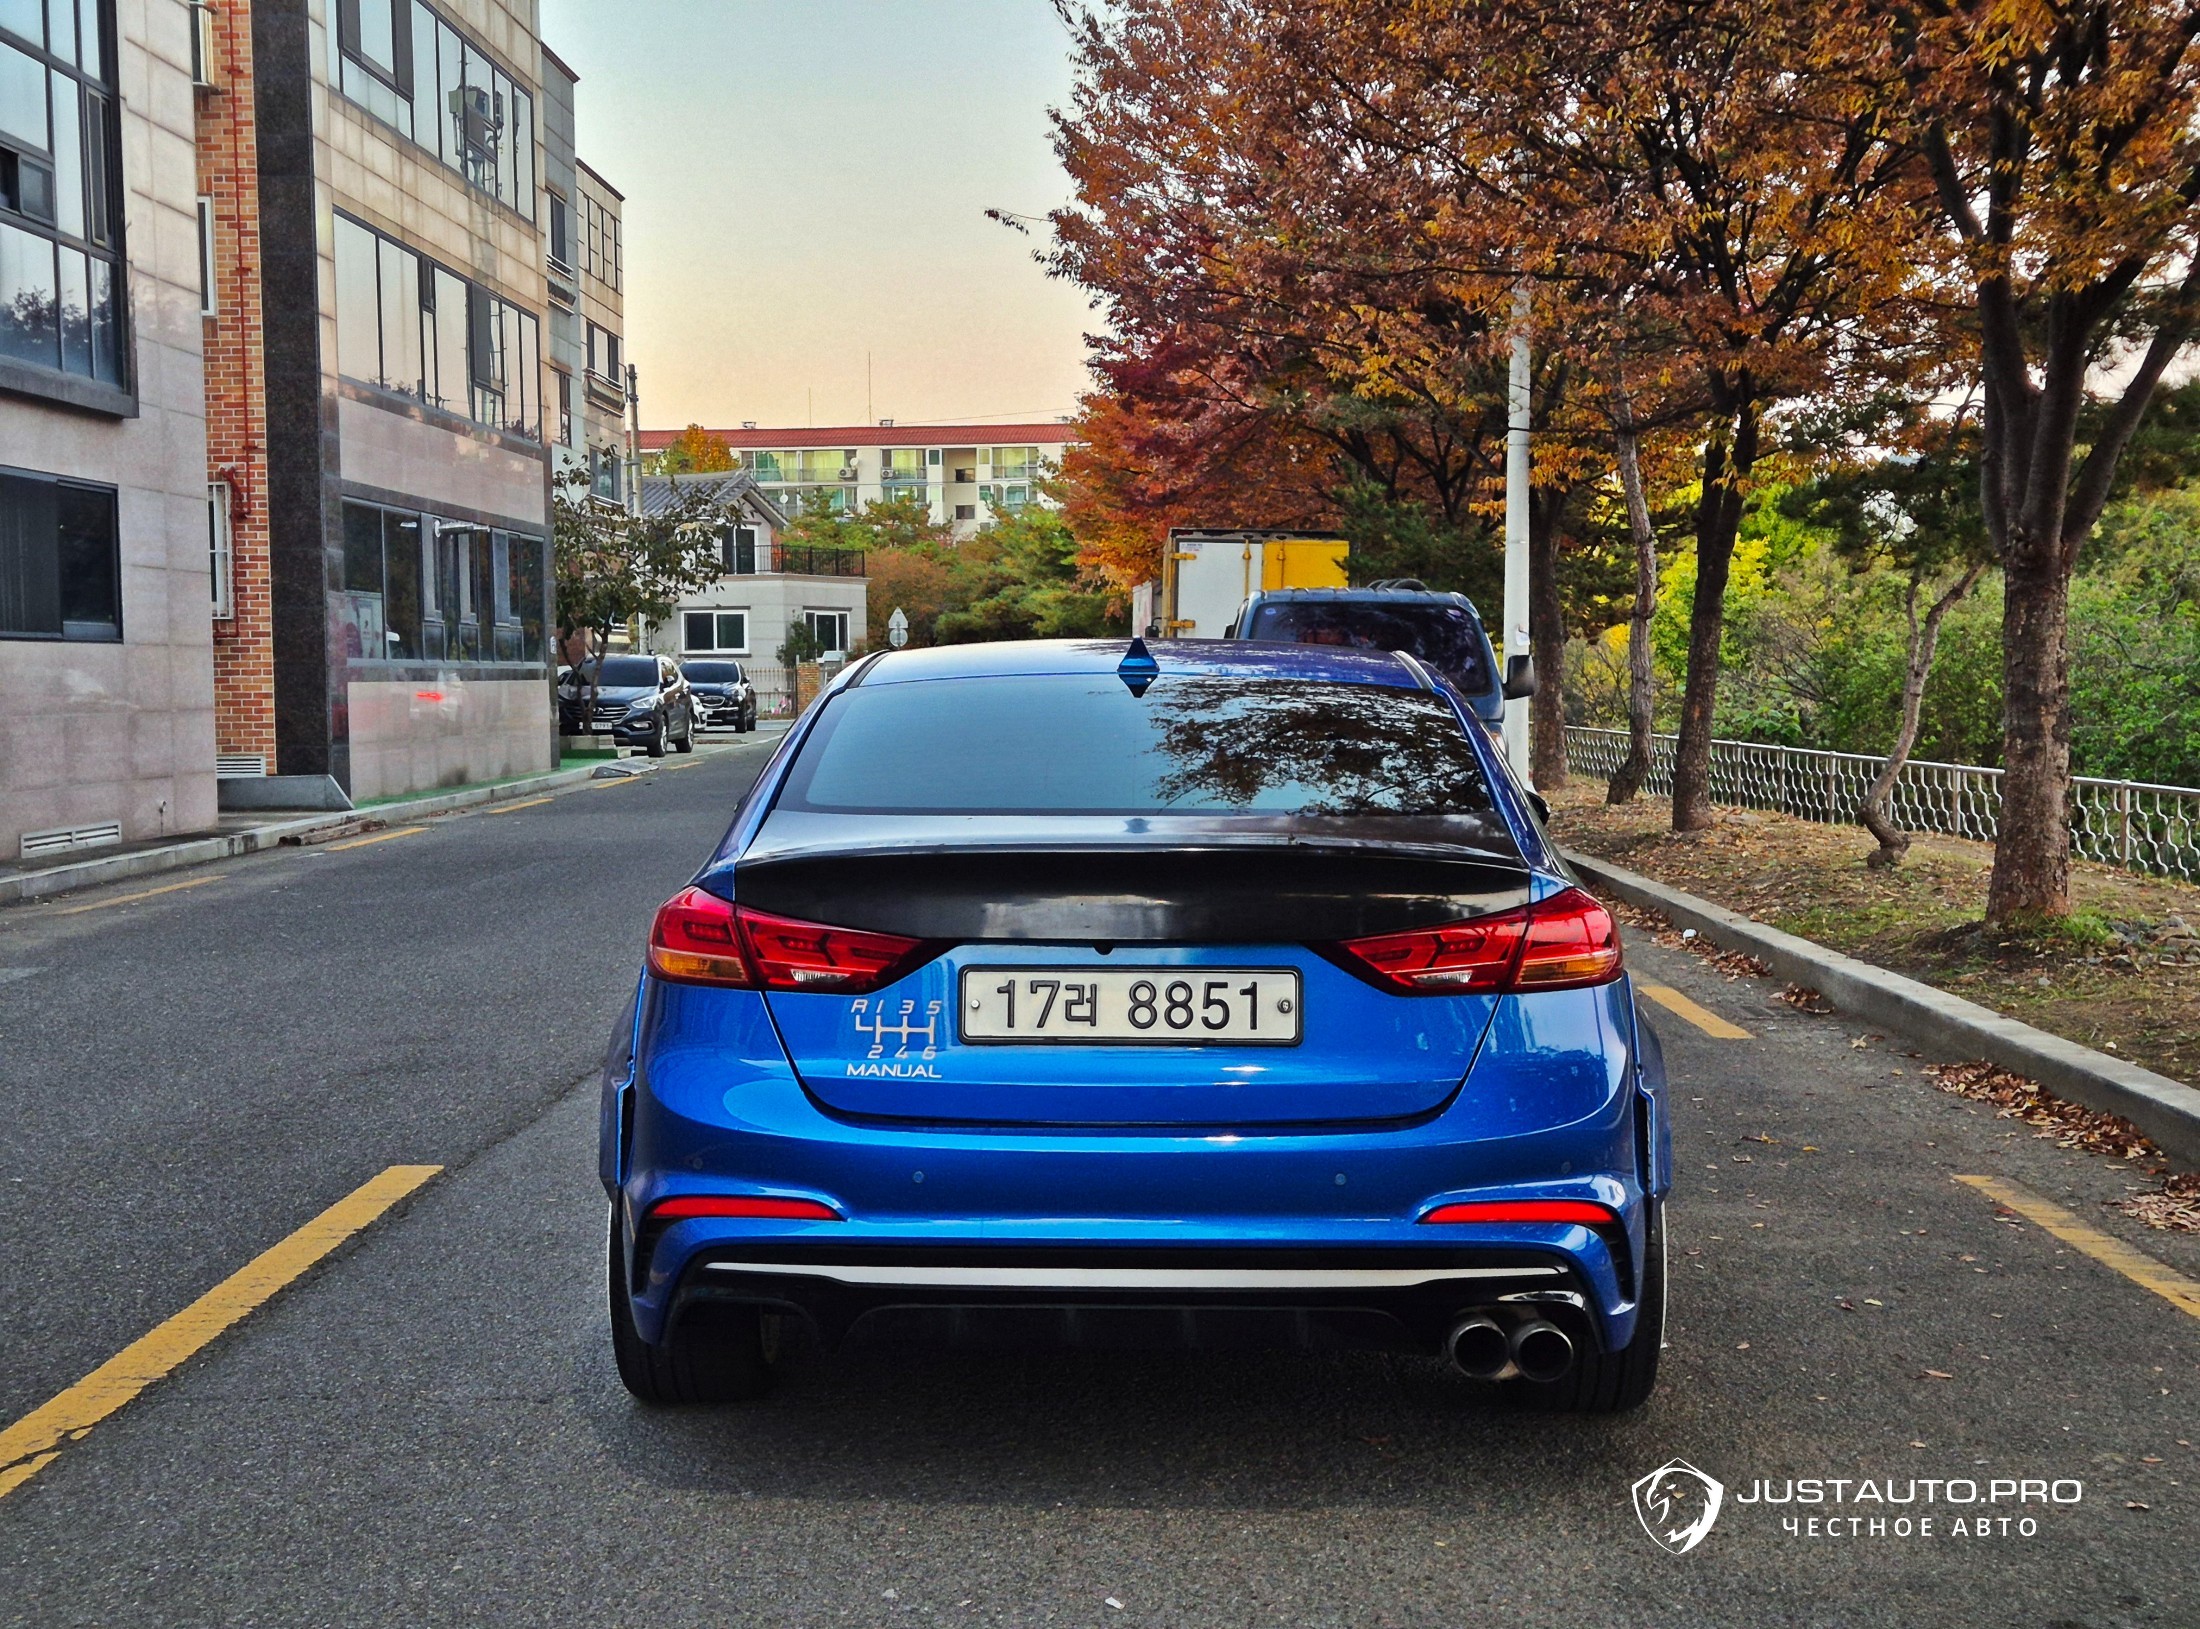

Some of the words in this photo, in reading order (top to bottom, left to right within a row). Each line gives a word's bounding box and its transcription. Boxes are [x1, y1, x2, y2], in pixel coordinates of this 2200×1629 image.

[899, 1000, 915, 1014] 3
[926, 1000, 942, 1015] 5
[997, 980, 1097, 1028] 17러
[1128, 980, 1258, 1030] 8851
[867, 1045, 883, 1059] 2
[894, 1045, 908, 1059] 4
[922, 1046, 937, 1060] 6
[846, 1063, 942, 1078] MANUAL
